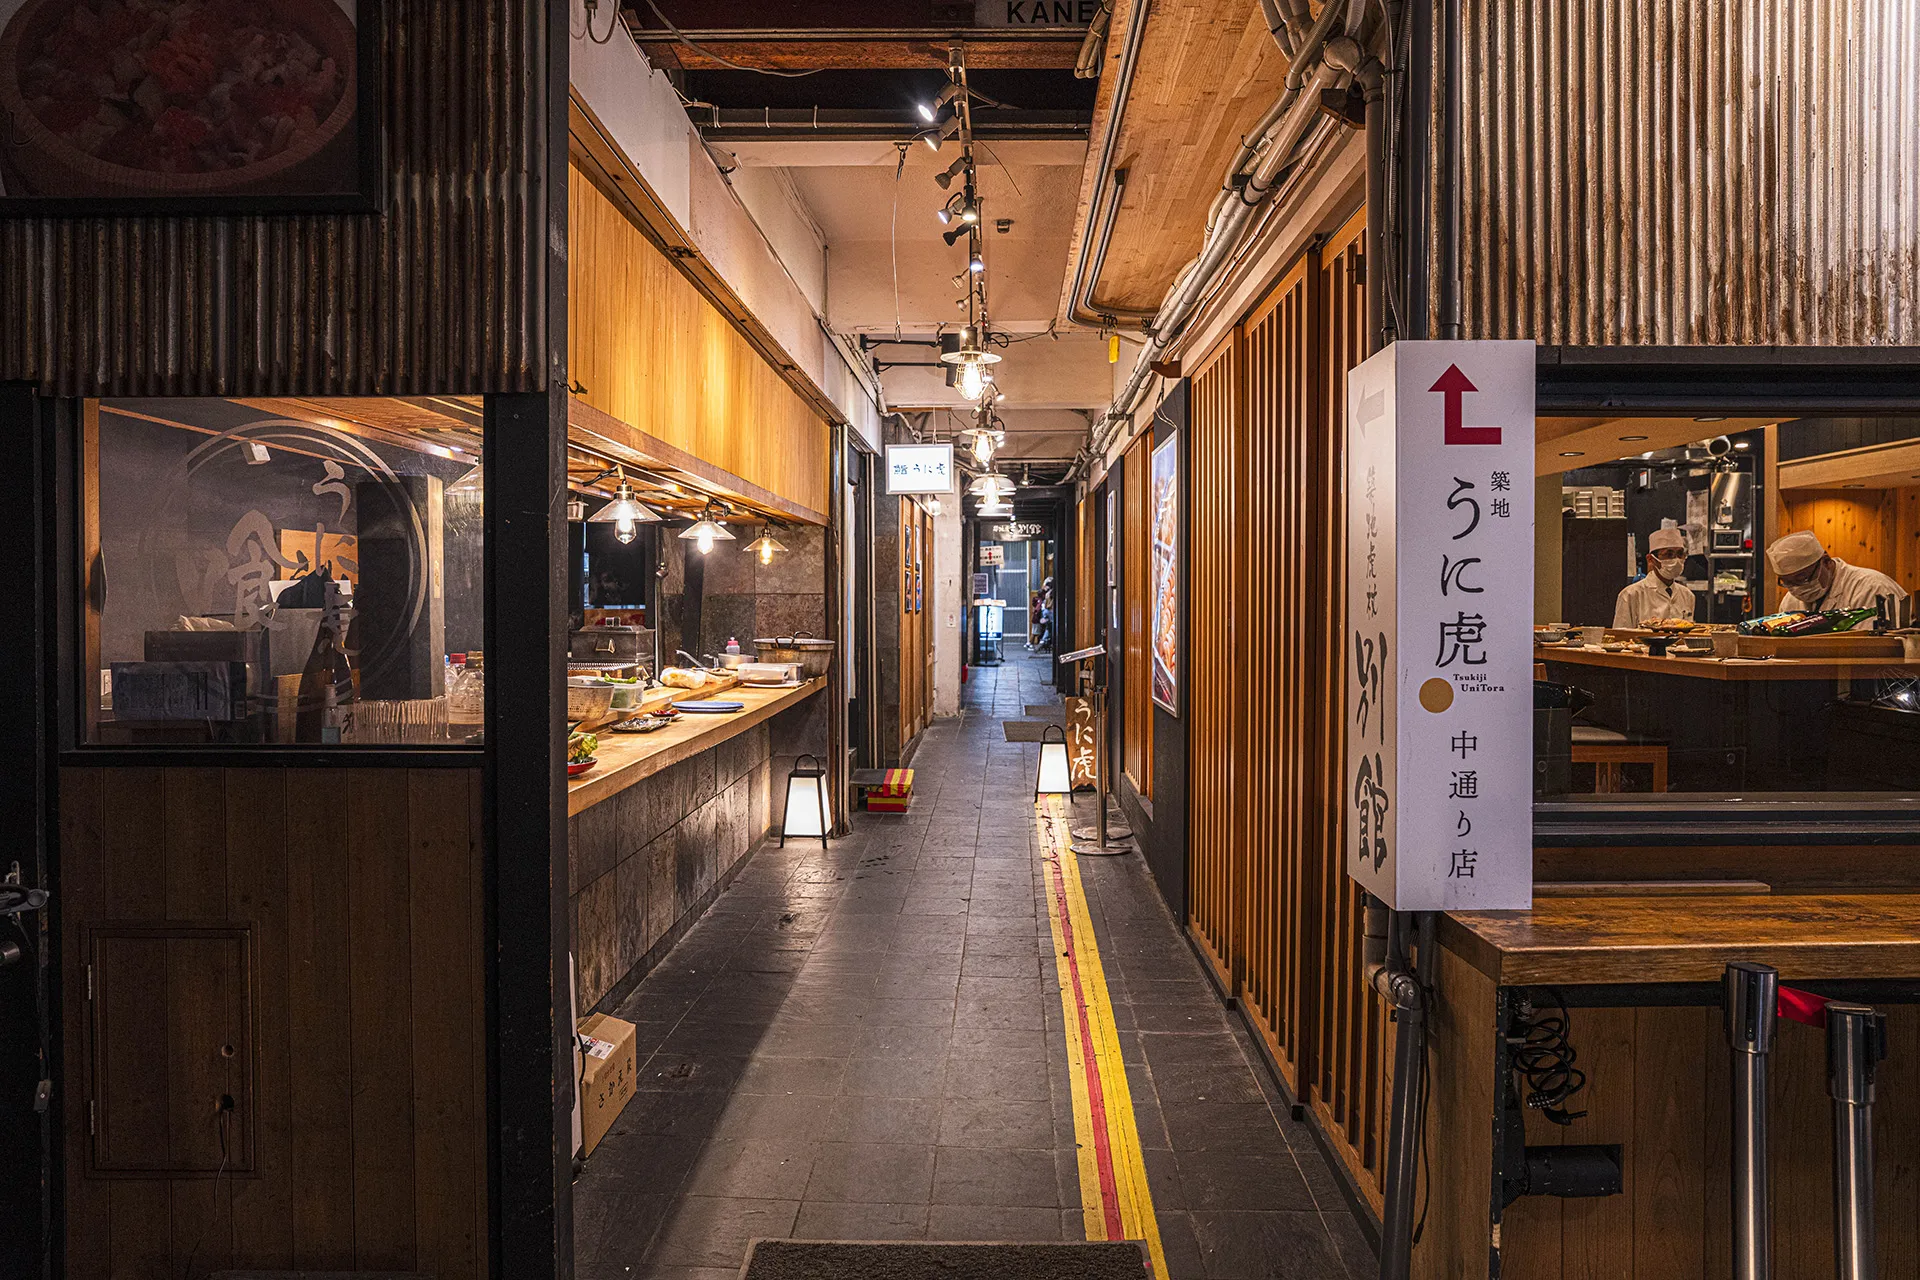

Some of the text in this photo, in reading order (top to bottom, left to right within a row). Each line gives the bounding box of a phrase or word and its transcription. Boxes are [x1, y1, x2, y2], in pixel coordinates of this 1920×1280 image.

[1490, 471, 1511, 518] 築地
[1436, 477, 1488, 668] うに虎
[1453, 673, 1487, 682] Tsukiji
[1461, 683, 1505, 692] UniTora
[1071, 698, 1096, 782] うに虎
[1448, 730, 1479, 879] 中通り店
